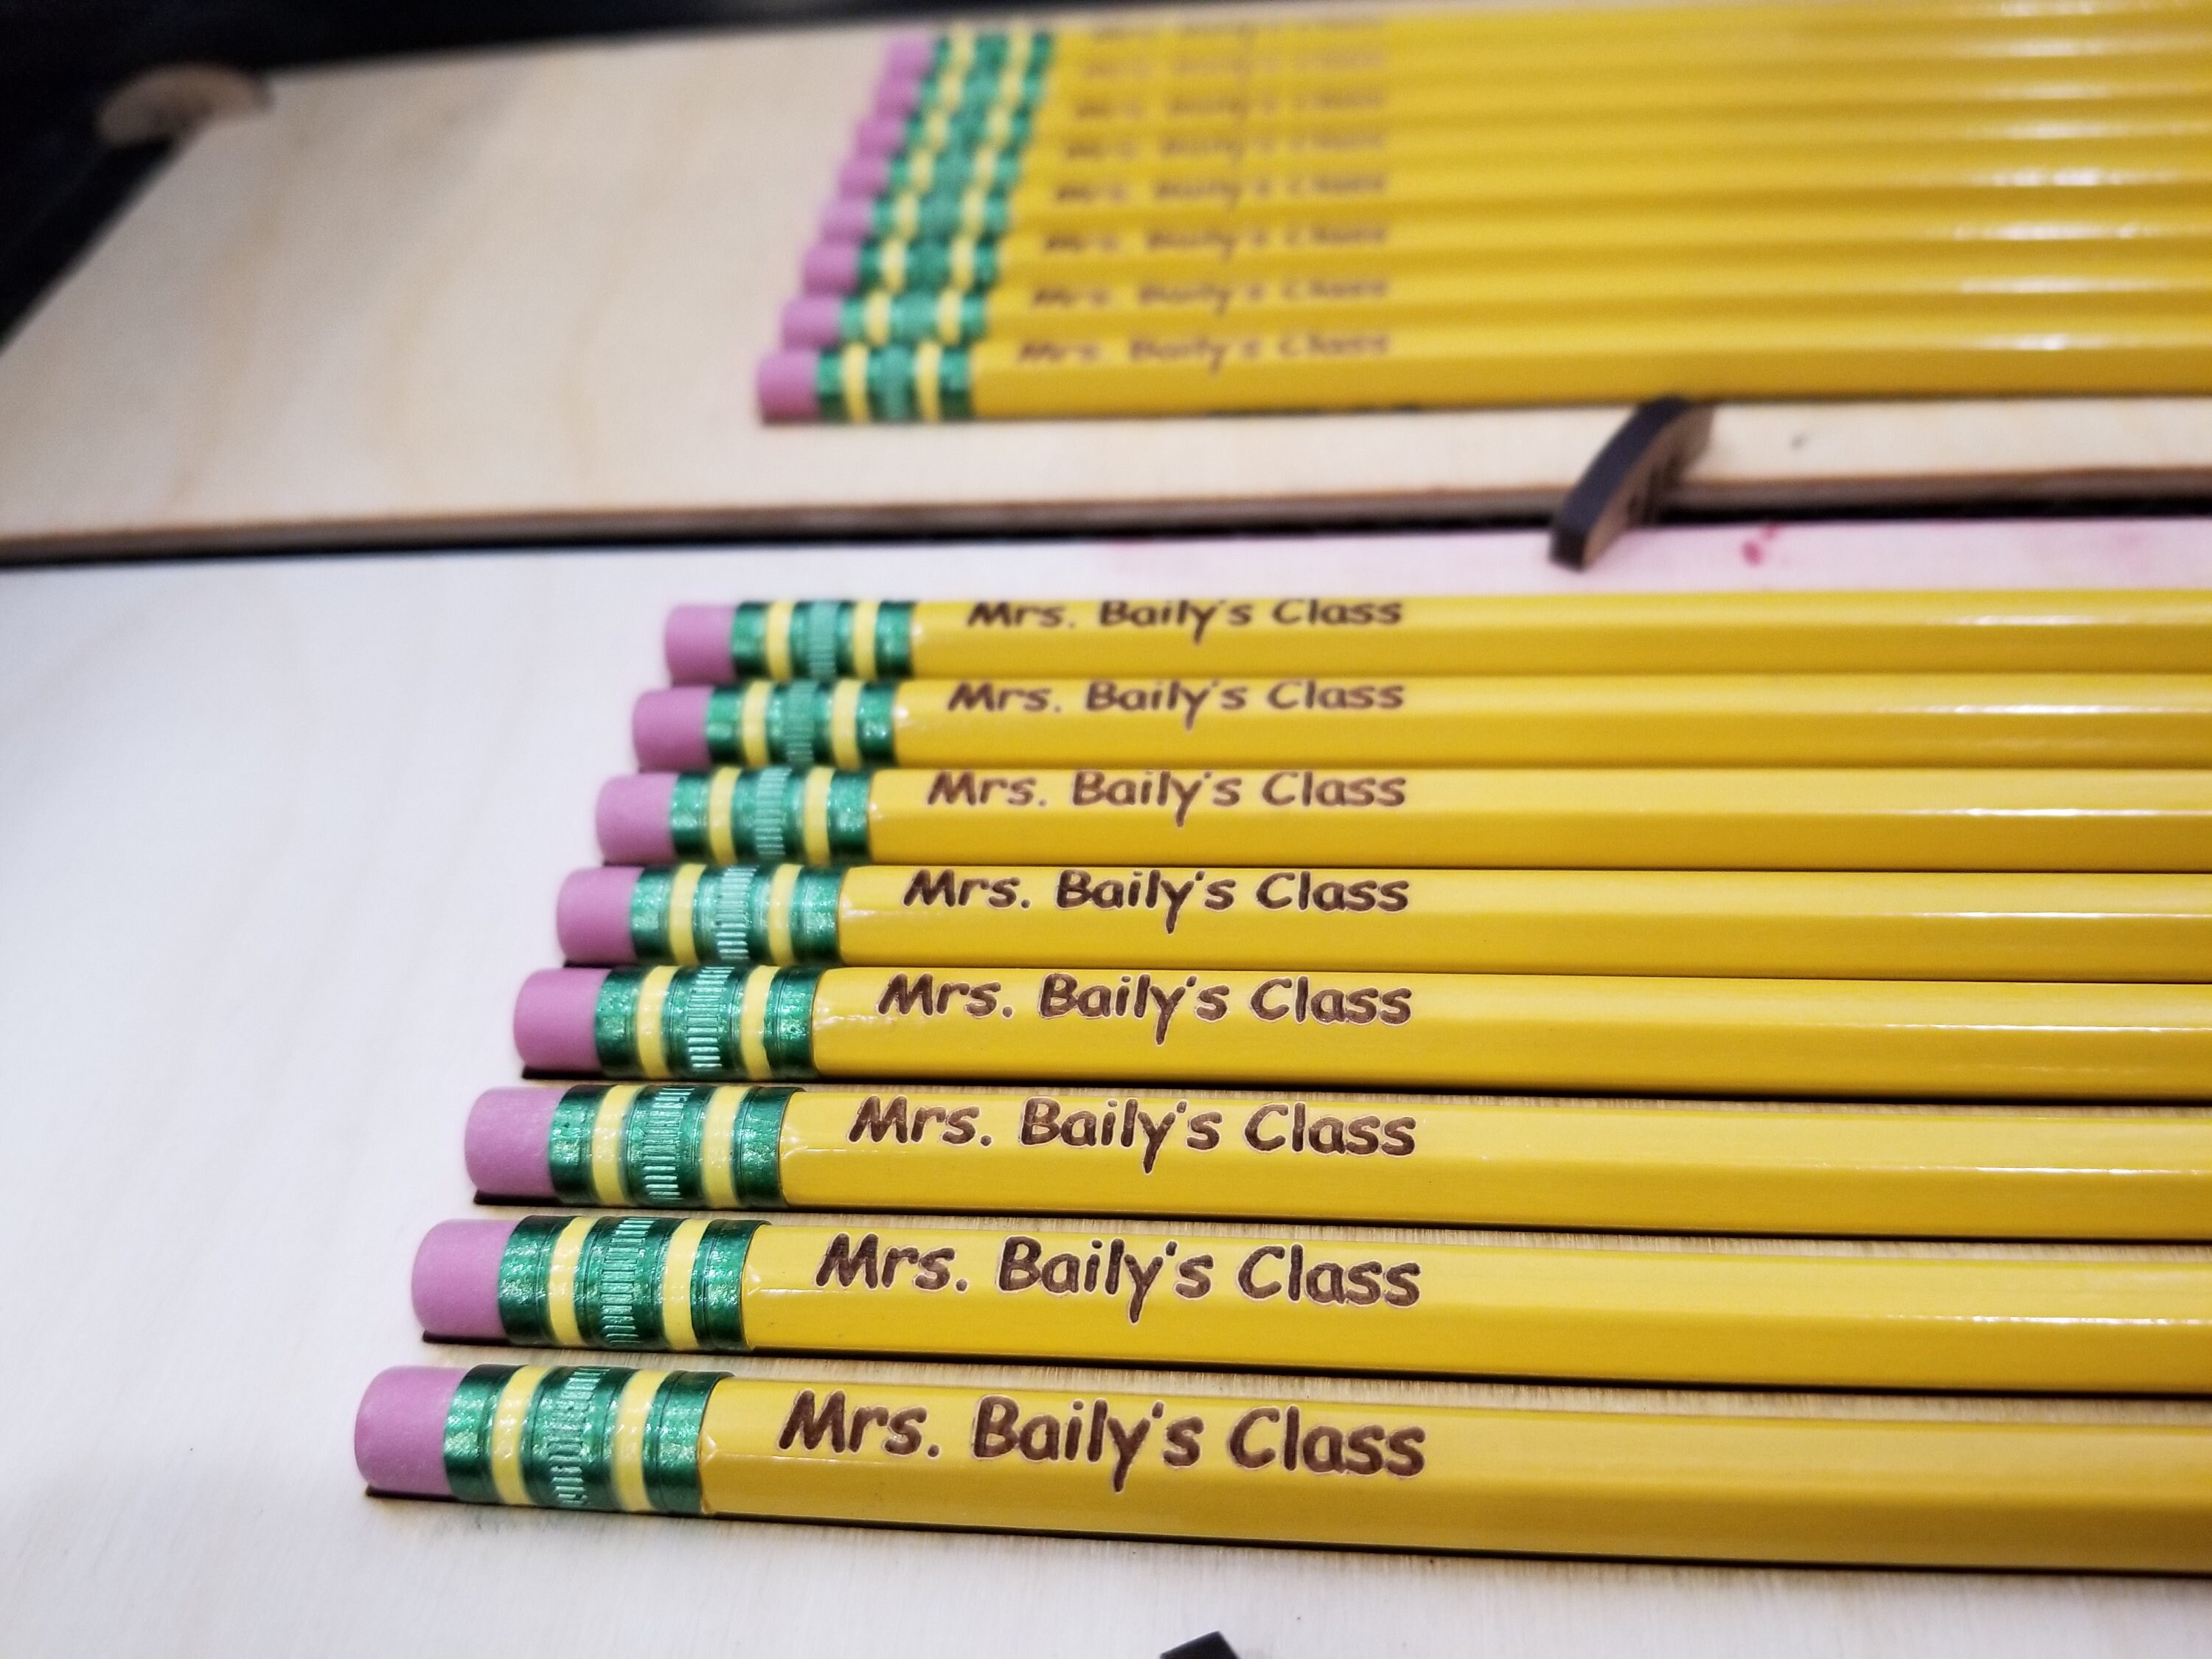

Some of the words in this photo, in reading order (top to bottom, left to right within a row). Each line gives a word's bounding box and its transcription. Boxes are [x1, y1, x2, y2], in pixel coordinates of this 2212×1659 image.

[967, 601, 1076, 628] Mrs.
[1098, 599, 1253, 645] Baily's
[1271, 599, 1402, 626] Class
[947, 681, 1062, 713] Mrs.
[1085, 680, 1248, 729] Baily's
[1267, 680, 1404, 711] Class
[926, 771, 1046, 807] Mrs.
[1071, 770, 1242, 827] Baily's
[1261, 771, 1406, 807] Class
[903, 869, 1030, 909] Mrs.
[1056, 869, 1237, 934] Baily's
[1256, 871, 1410, 912] Class
[877, 973, 1012, 1018] Mrs.
[1040, 973, 1230, 1045] Baily's
[1250, 976, 1413, 1024] Class
[848, 1095, 992, 1146] Mrs.
[1020, 1096, 1222, 1173] Baily's
[1245, 1102, 1416, 1155] Class
[815, 1233, 967, 1291] Mrs.
[998, 1236, 1214, 1324] Baily's
[1237, 1244, 1421, 1307] Class
[778, 1391, 939, 1457] Mrs.
[973, 1396, 1204, 1492] Baily's
[1228, 1405, 1426, 1476] Class
